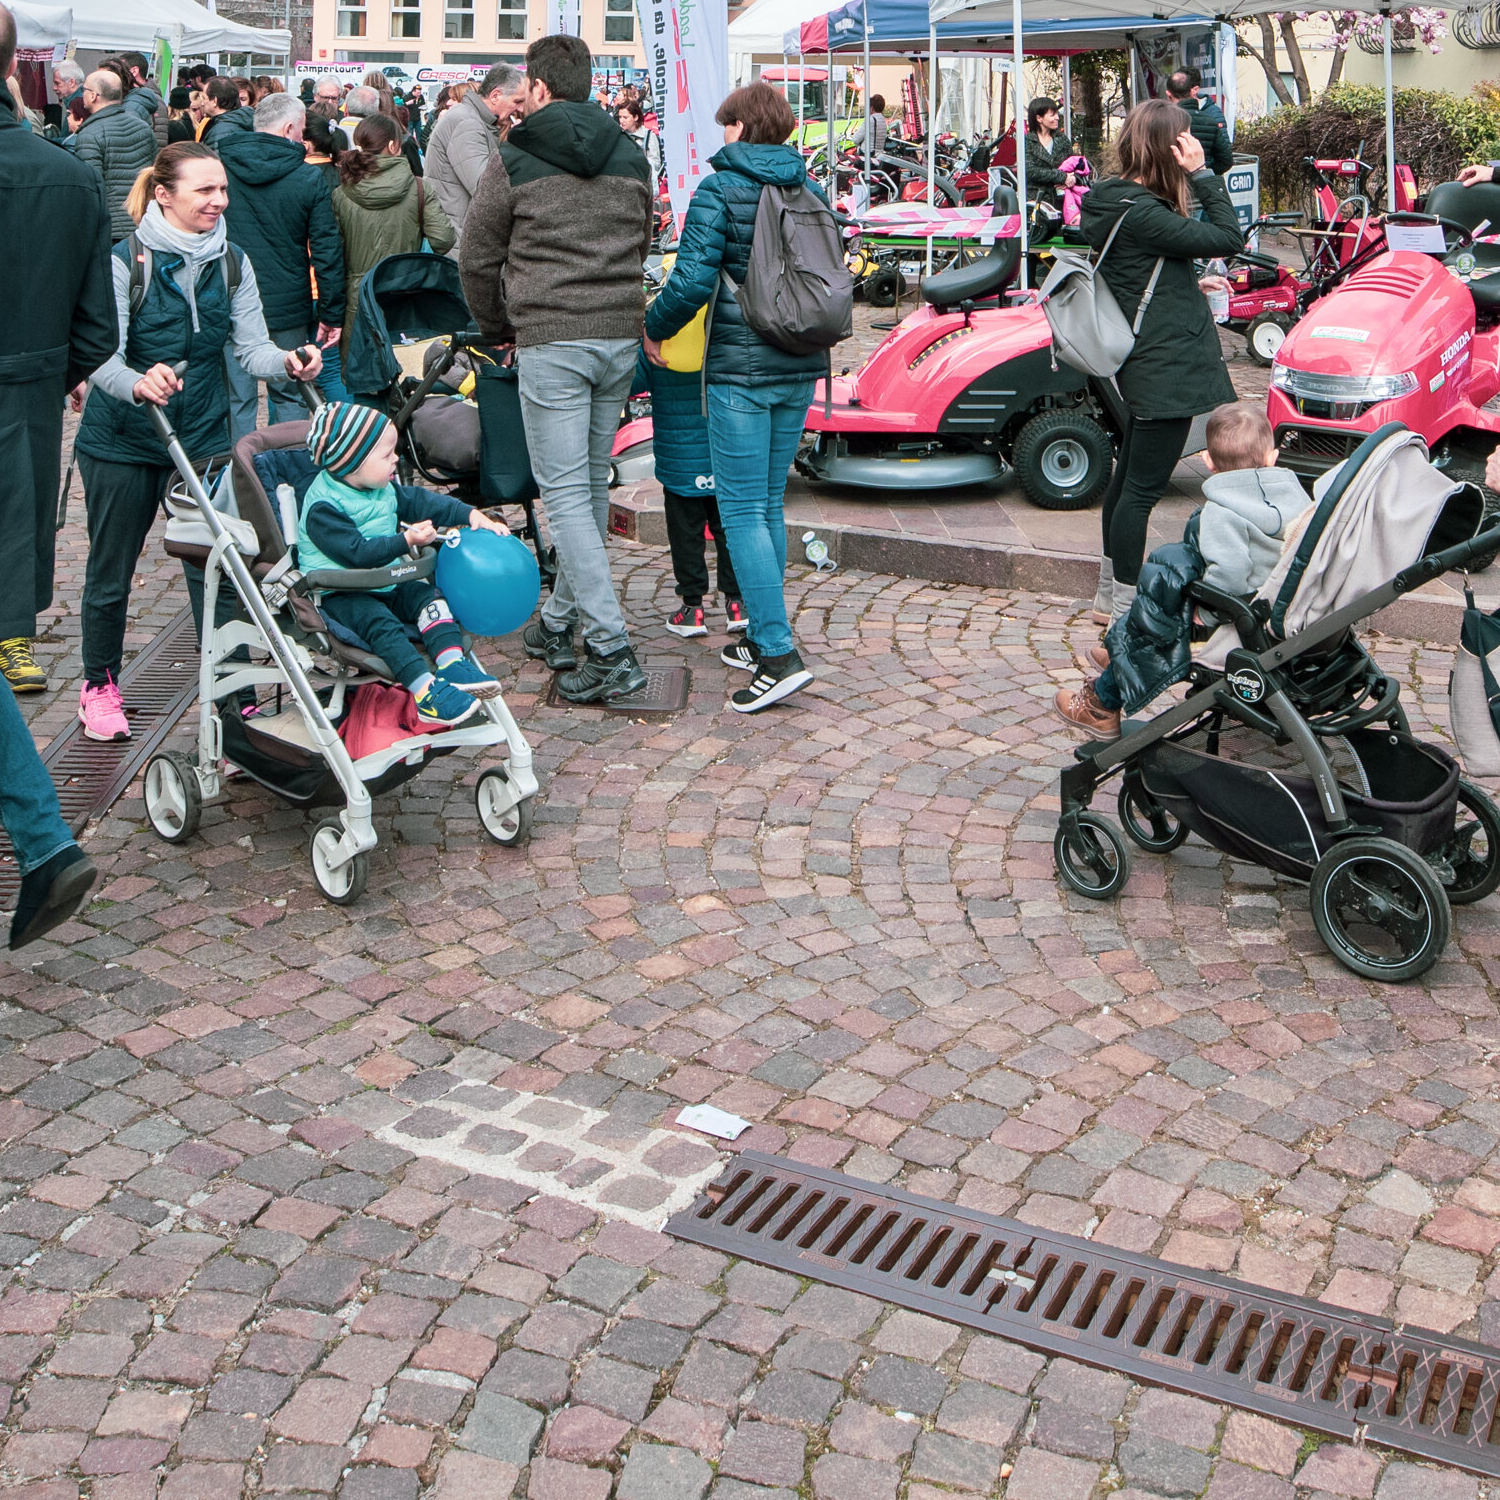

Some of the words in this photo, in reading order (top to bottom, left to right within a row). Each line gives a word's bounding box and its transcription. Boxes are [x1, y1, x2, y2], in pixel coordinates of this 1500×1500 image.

[297, 64, 363, 75] campertours
[1439, 330, 1471, 367] HONDA
[390, 564, 417, 577] Inglesina
[428, 603, 441, 621] 8
